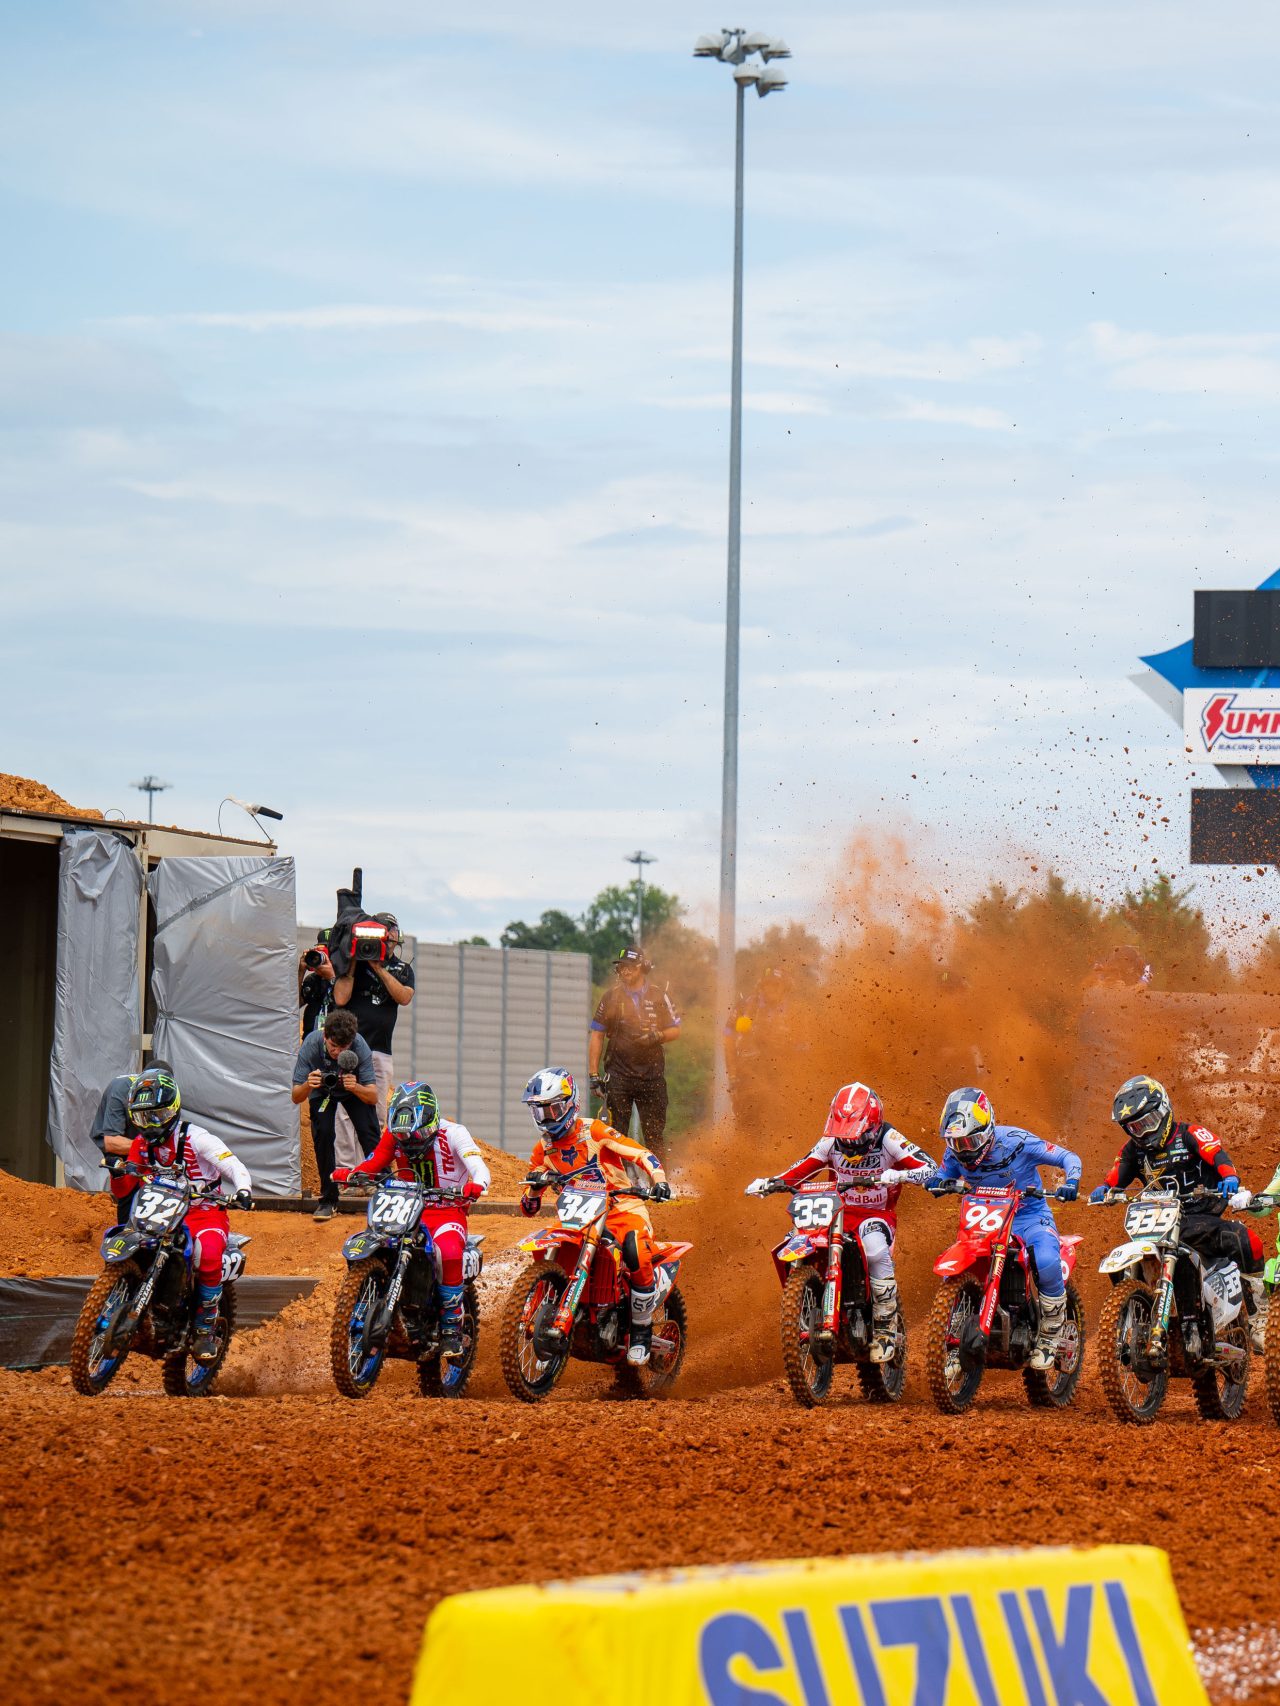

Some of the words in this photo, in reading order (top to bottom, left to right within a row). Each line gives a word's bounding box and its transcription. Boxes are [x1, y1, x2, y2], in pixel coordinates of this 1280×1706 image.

[837, 1168, 884, 1176] GASGAS
[134, 1191, 184, 1226] 32
[371, 1193, 420, 1225] 238
[558, 1193, 604, 1227] 34
[793, 1198, 834, 1228] 33
[863, 1193, 883, 1203] Bull
[964, 1205, 1005, 1232] 96
[1126, 1208, 1176, 1234] 339
[221, 1252, 242, 1282] 32
[387, 1272, 403, 1312] DUNLOP
[986, 1288, 999, 1329] DUNLOP
